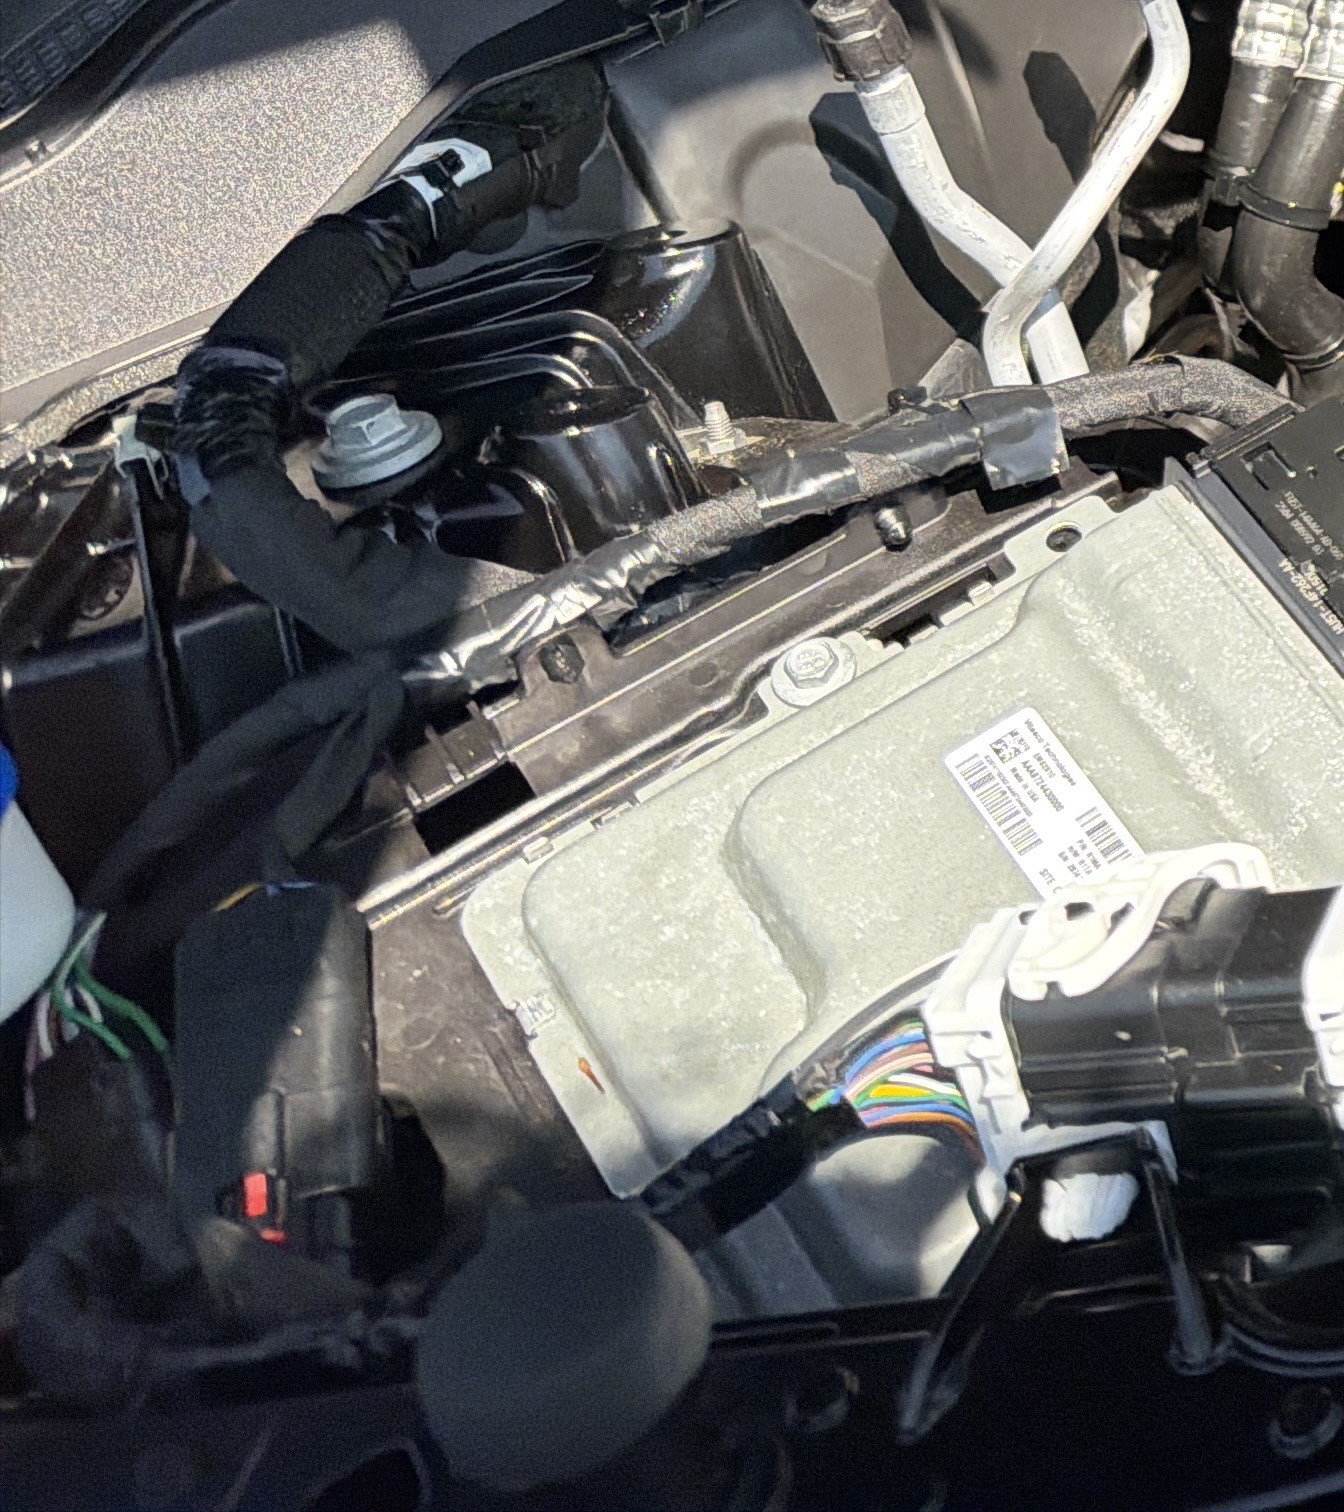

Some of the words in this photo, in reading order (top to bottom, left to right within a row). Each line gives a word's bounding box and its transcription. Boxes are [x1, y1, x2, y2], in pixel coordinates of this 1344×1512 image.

[1041, 744, 1077, 787] Technologies
[1008, 766, 1025, 783] Made
[1021, 782, 1030, 790] in
[1026, 789, 1040, 803] USA
[1038, 867, 1056, 885] SITE
